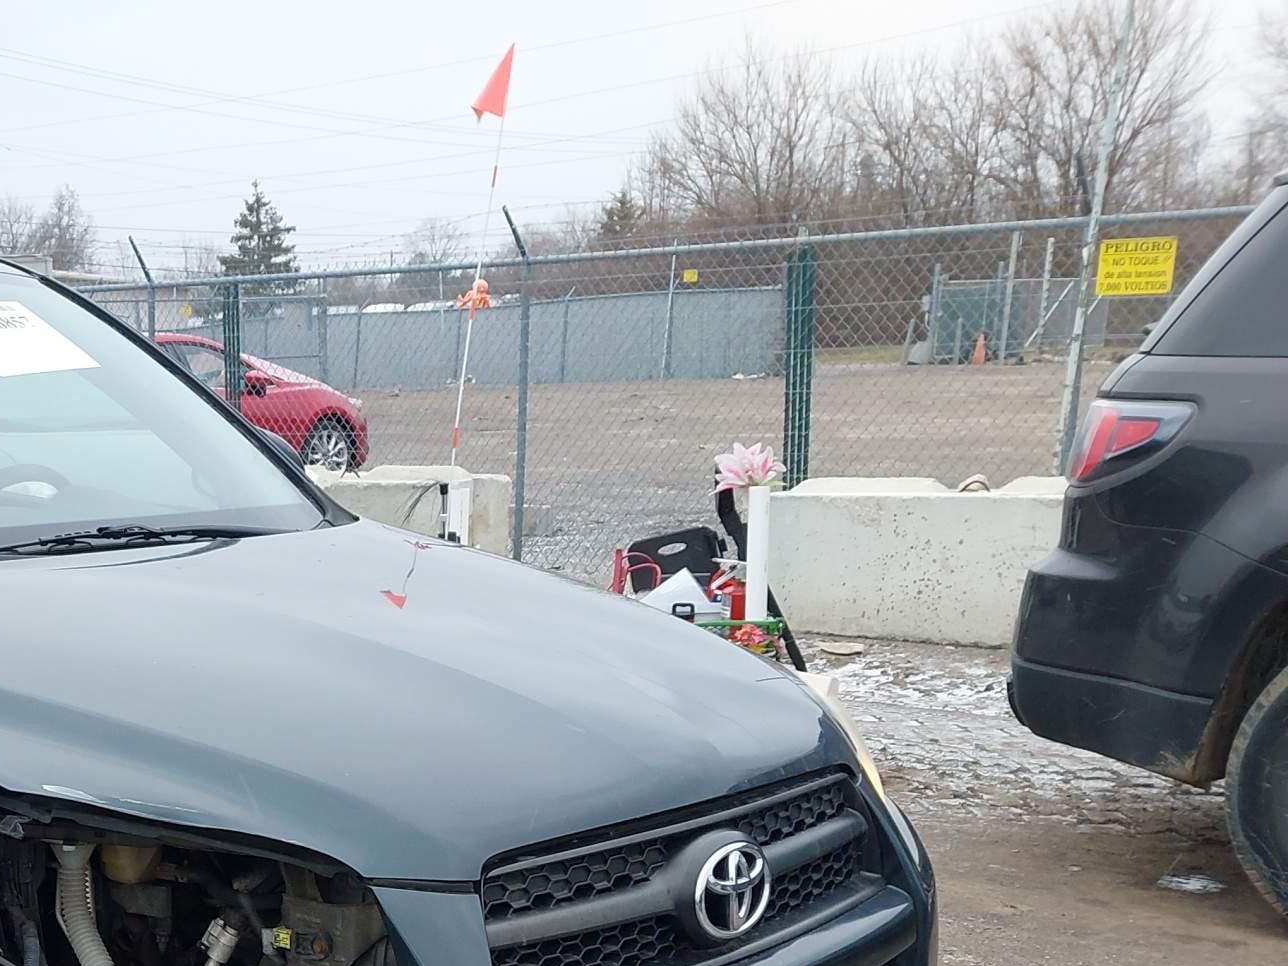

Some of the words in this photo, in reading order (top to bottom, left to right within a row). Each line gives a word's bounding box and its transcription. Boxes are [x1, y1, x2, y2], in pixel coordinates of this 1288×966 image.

[1105, 241, 1172, 253] PELIGRO
[1112, 257, 1125, 266] NO
[1128, 256, 1160, 265] TOQUE
[1124, 281, 1168, 291] VOLTIOS
